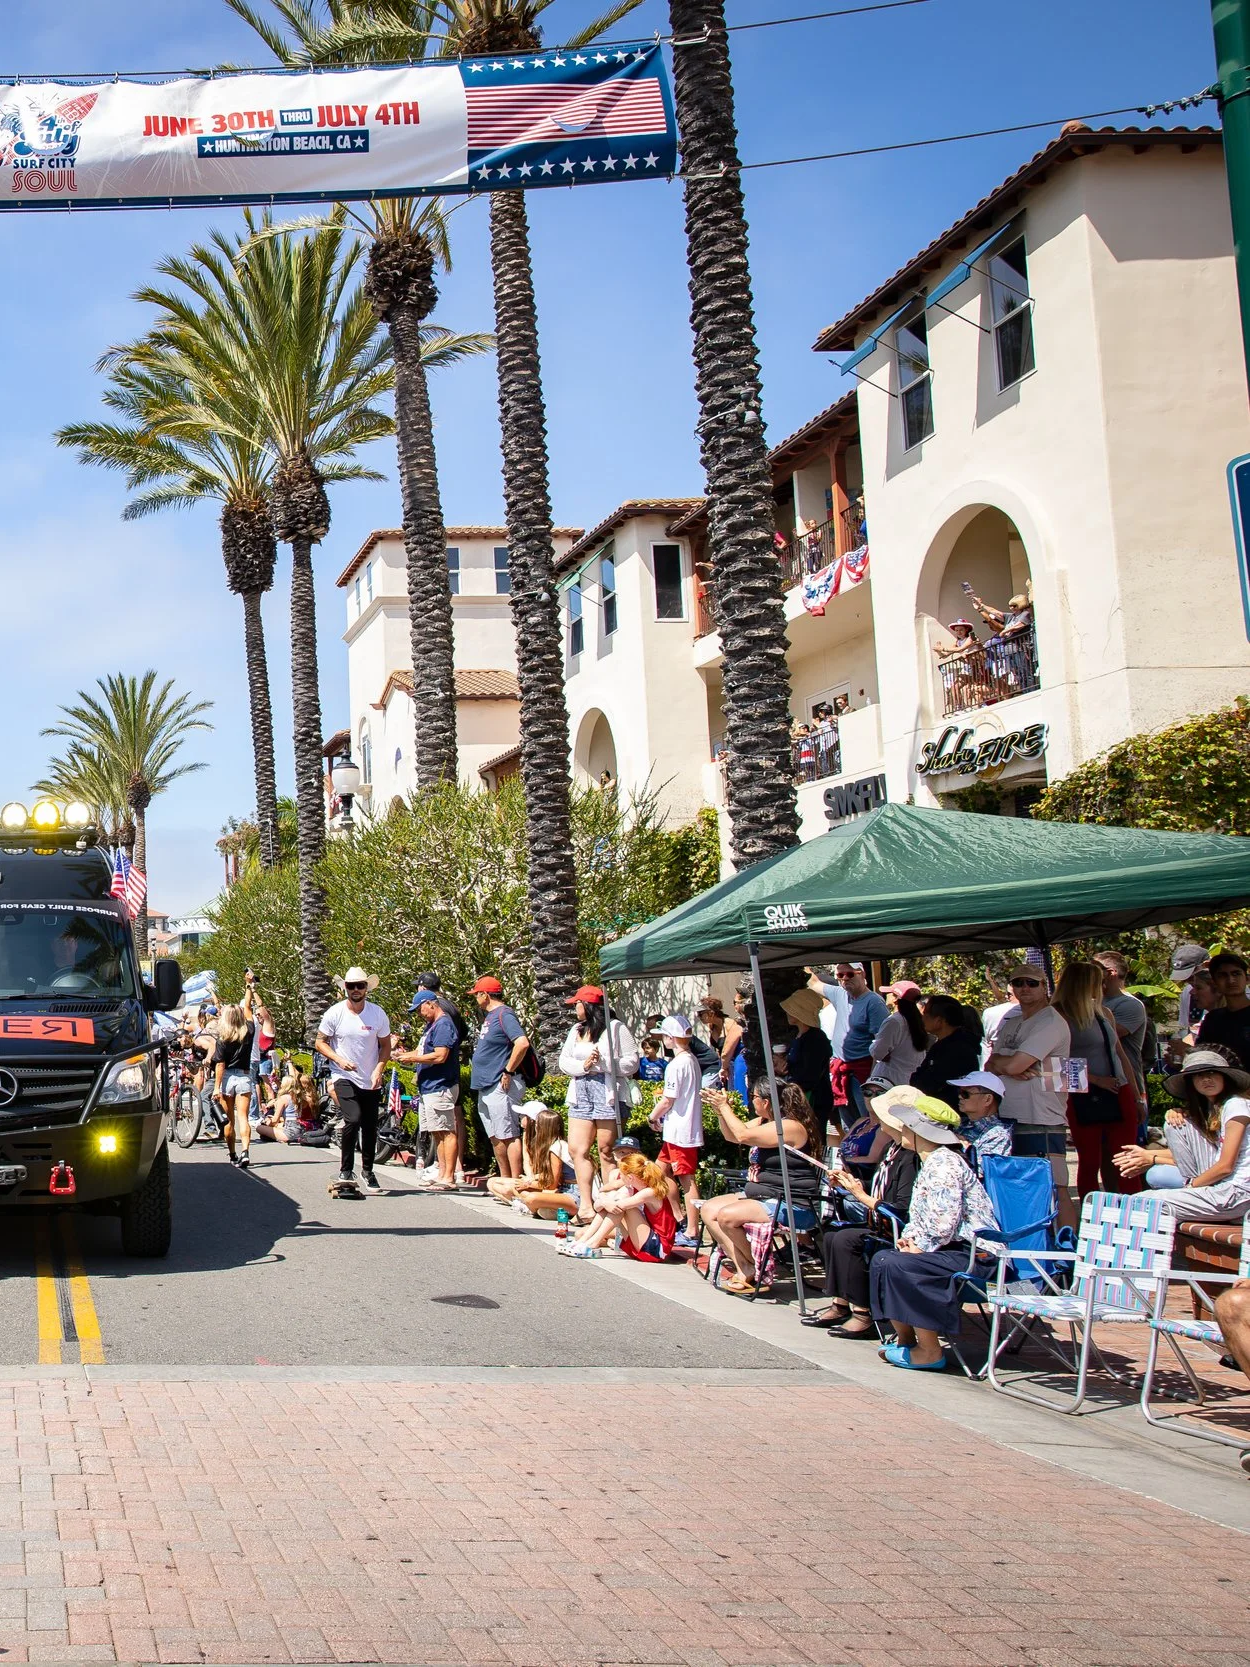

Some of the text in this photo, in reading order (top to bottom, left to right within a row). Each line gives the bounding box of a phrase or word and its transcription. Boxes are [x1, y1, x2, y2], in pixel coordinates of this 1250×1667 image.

[143, 101, 420, 137] JUNE 30TH THRU JULY 4TH
[293, 136, 333, 151] BEACH,
[336, 134, 352, 149] CA
[13, 158, 77, 169] SURF CITY
[12, 170, 78, 193] SOUL
[915, 726, 975, 773] Shabu
[976, 724, 1046, 765] FIRE
[763, 903, 805, 919] QUIK
[766, 916, 809, 930] SHADE
